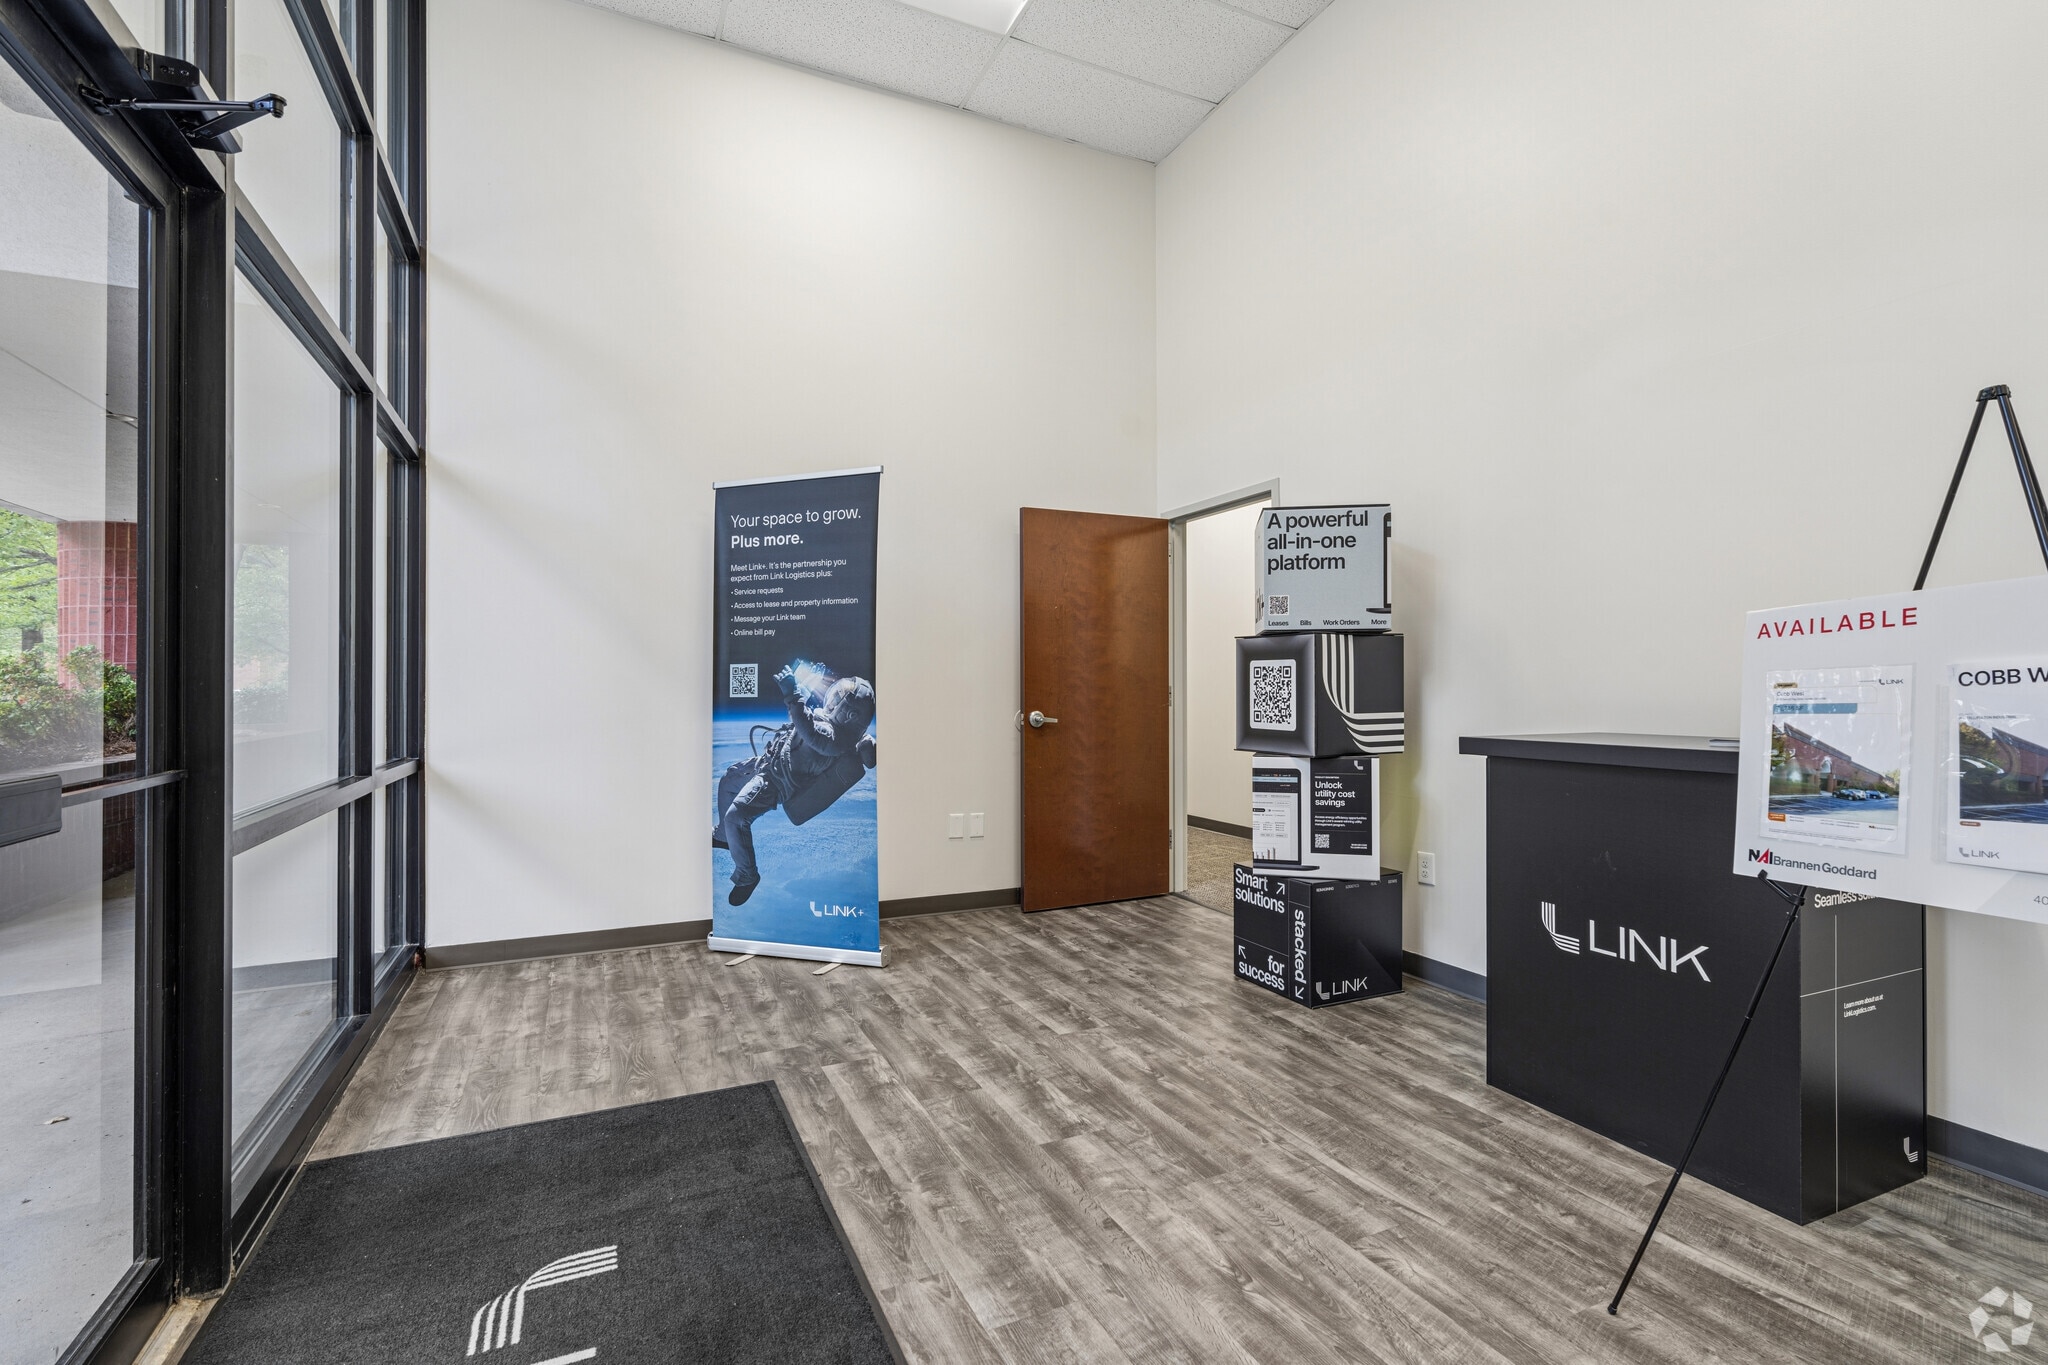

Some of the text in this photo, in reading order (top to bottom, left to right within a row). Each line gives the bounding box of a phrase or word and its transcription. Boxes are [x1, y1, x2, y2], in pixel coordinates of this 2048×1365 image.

[730, 508, 862, 528] Your space to grow.
[1267, 510, 1368, 532] A powerful
[731, 534, 804, 549] Plus more.
[1267, 532, 1356, 550] all-in-one
[748, 562, 768, 570] Link+.
[768, 562, 779, 570] It's
[792, 558, 832, 570] partnership
[833, 559, 846, 567] you
[1267, 554, 1346, 575] platform
[730, 574, 752, 583] expect
[785, 570, 815, 580] Logistics
[816, 570, 833, 579] plus:
[757, 587, 784, 595] requests
[794, 599, 821, 608] property
[1757, 607, 1918, 640] AVAILABLE
[1958, 668, 2022, 687] COBB
[1315, 781, 1342, 789] Unlock
[1315, 790, 1336, 799] utility
[1315, 798, 1345, 808] savings
[1748, 848, 1877, 880] NAI Brannen Goddard
[1971, 850, 2000, 859] LINK
[1235, 867, 1268, 892] Smart
[1235, 888, 1285, 914] solutions
[1814, 890, 1857, 908] Seamless
[1294, 909, 1307, 985] stacked
[1589, 919, 1711, 982] LINK
[1268, 955, 1285, 976] for
[1238, 961, 1285, 991] success
[1332, 977, 1368, 996] LINK
[1864, 996, 1875, 1004] about
